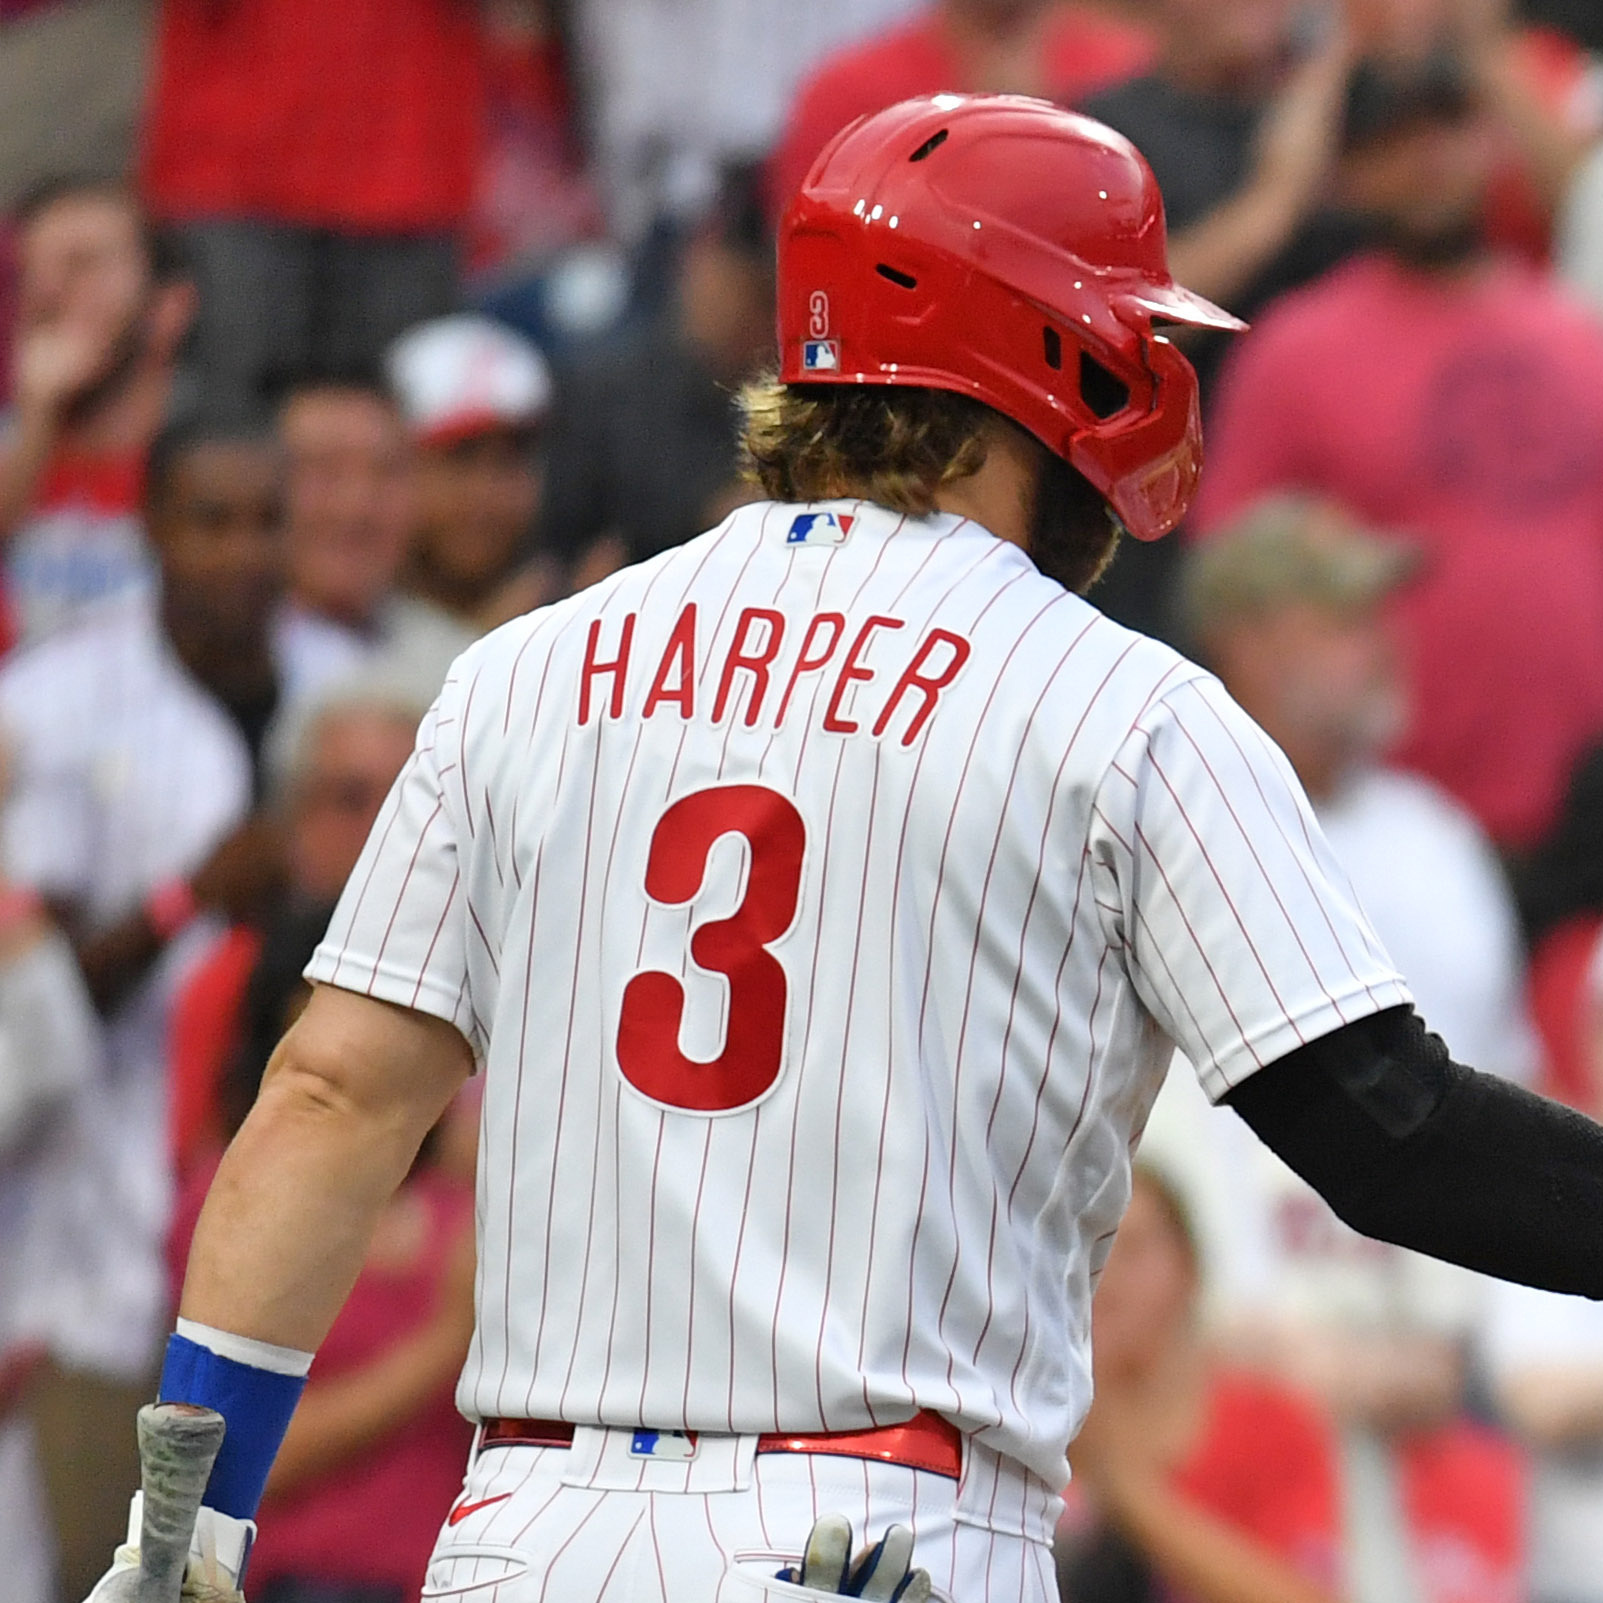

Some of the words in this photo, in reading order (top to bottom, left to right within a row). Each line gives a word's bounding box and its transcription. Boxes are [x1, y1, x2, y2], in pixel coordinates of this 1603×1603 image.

[809, 289, 829, 339] 3
[577, 602, 971, 747] HARPER
[616, 785, 807, 1112] 3
